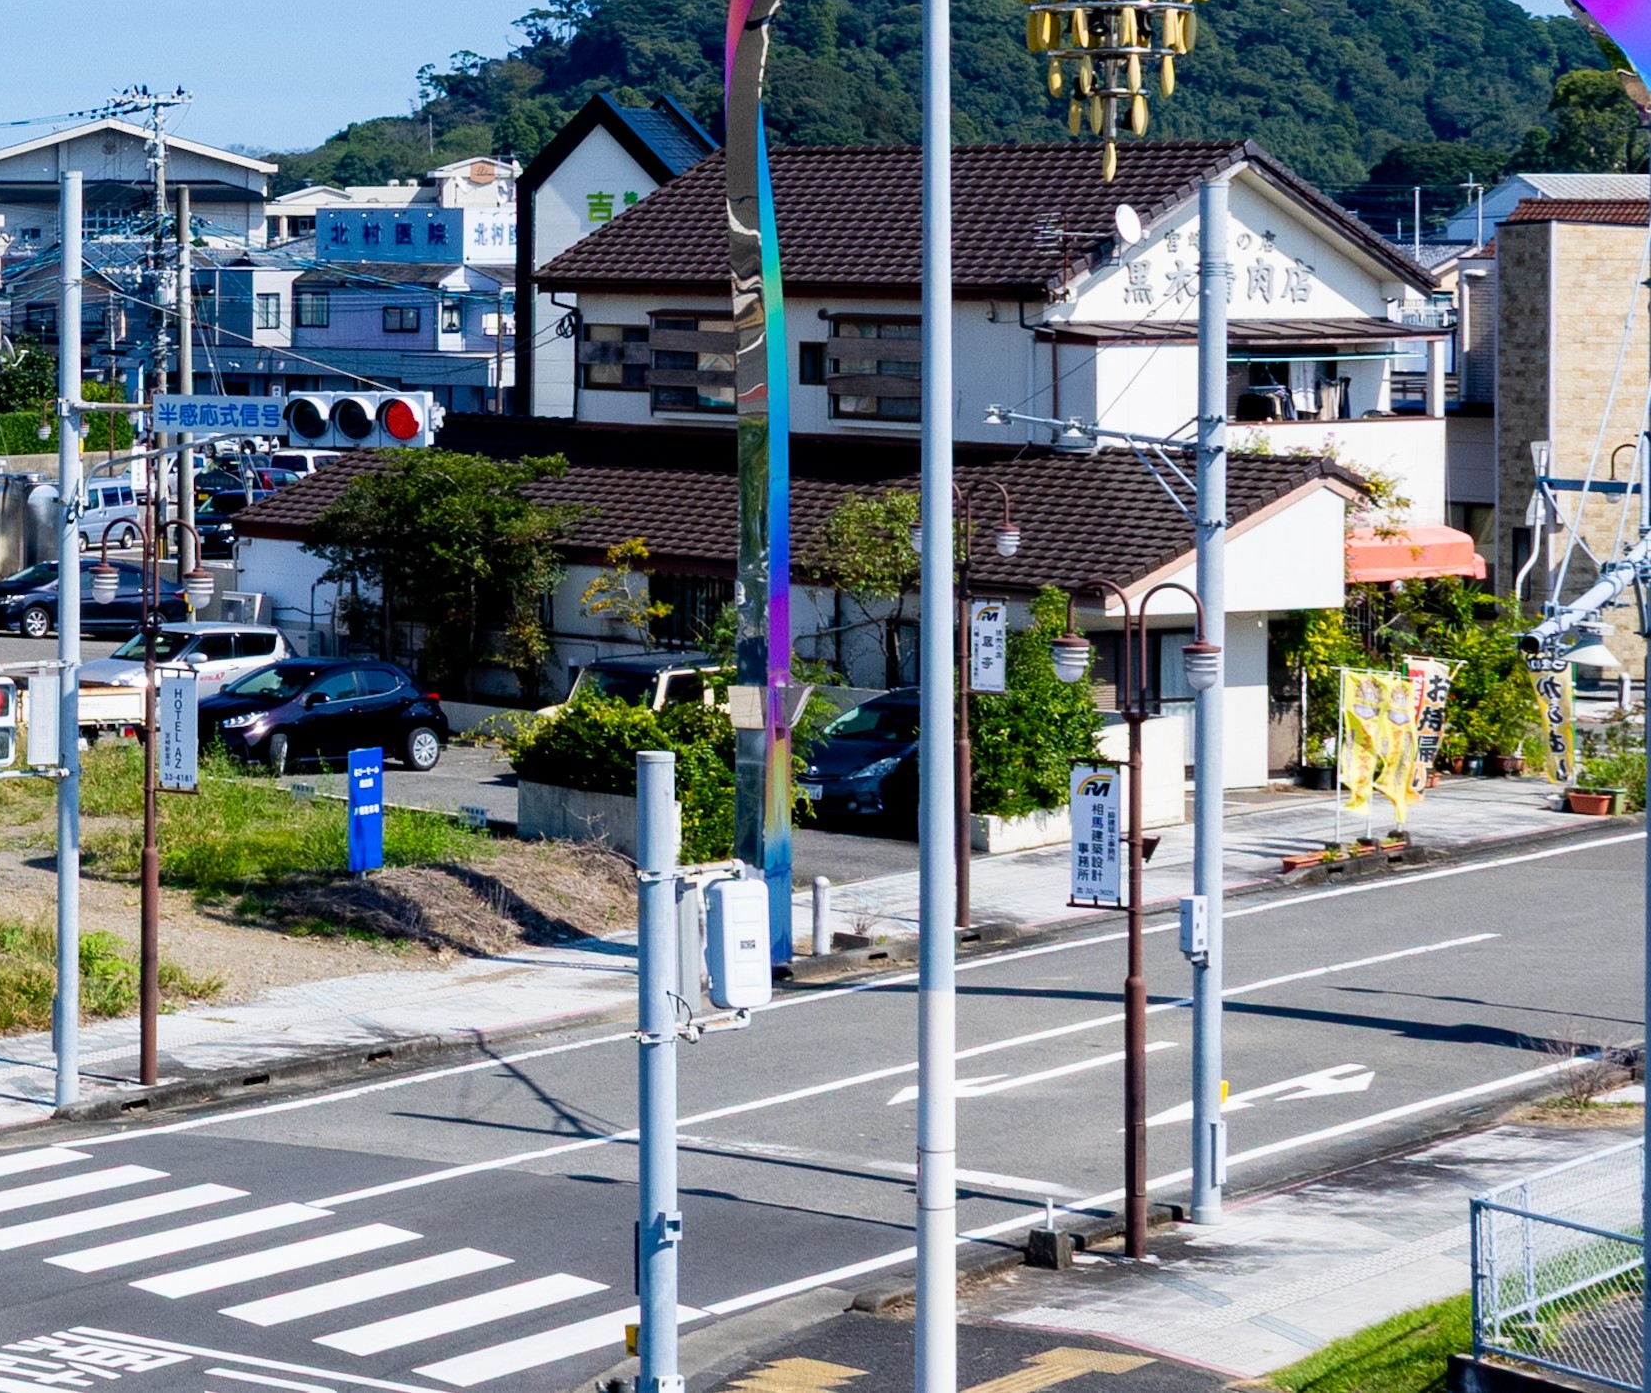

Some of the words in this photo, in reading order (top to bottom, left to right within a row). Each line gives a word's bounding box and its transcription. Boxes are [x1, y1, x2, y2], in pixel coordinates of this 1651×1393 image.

[330, 221, 449, 246] 北村医院
[159, 402, 281, 428] 半感応式信号
[174, 688, 183, 743] HOTEL
[174, 748, 183, 769] AZ
[164, 773, 193, 783] 33-4181
[1091, 803, 1104, 883] 相馬建築設計
[1077, 842, 1090, 882] 事務所
